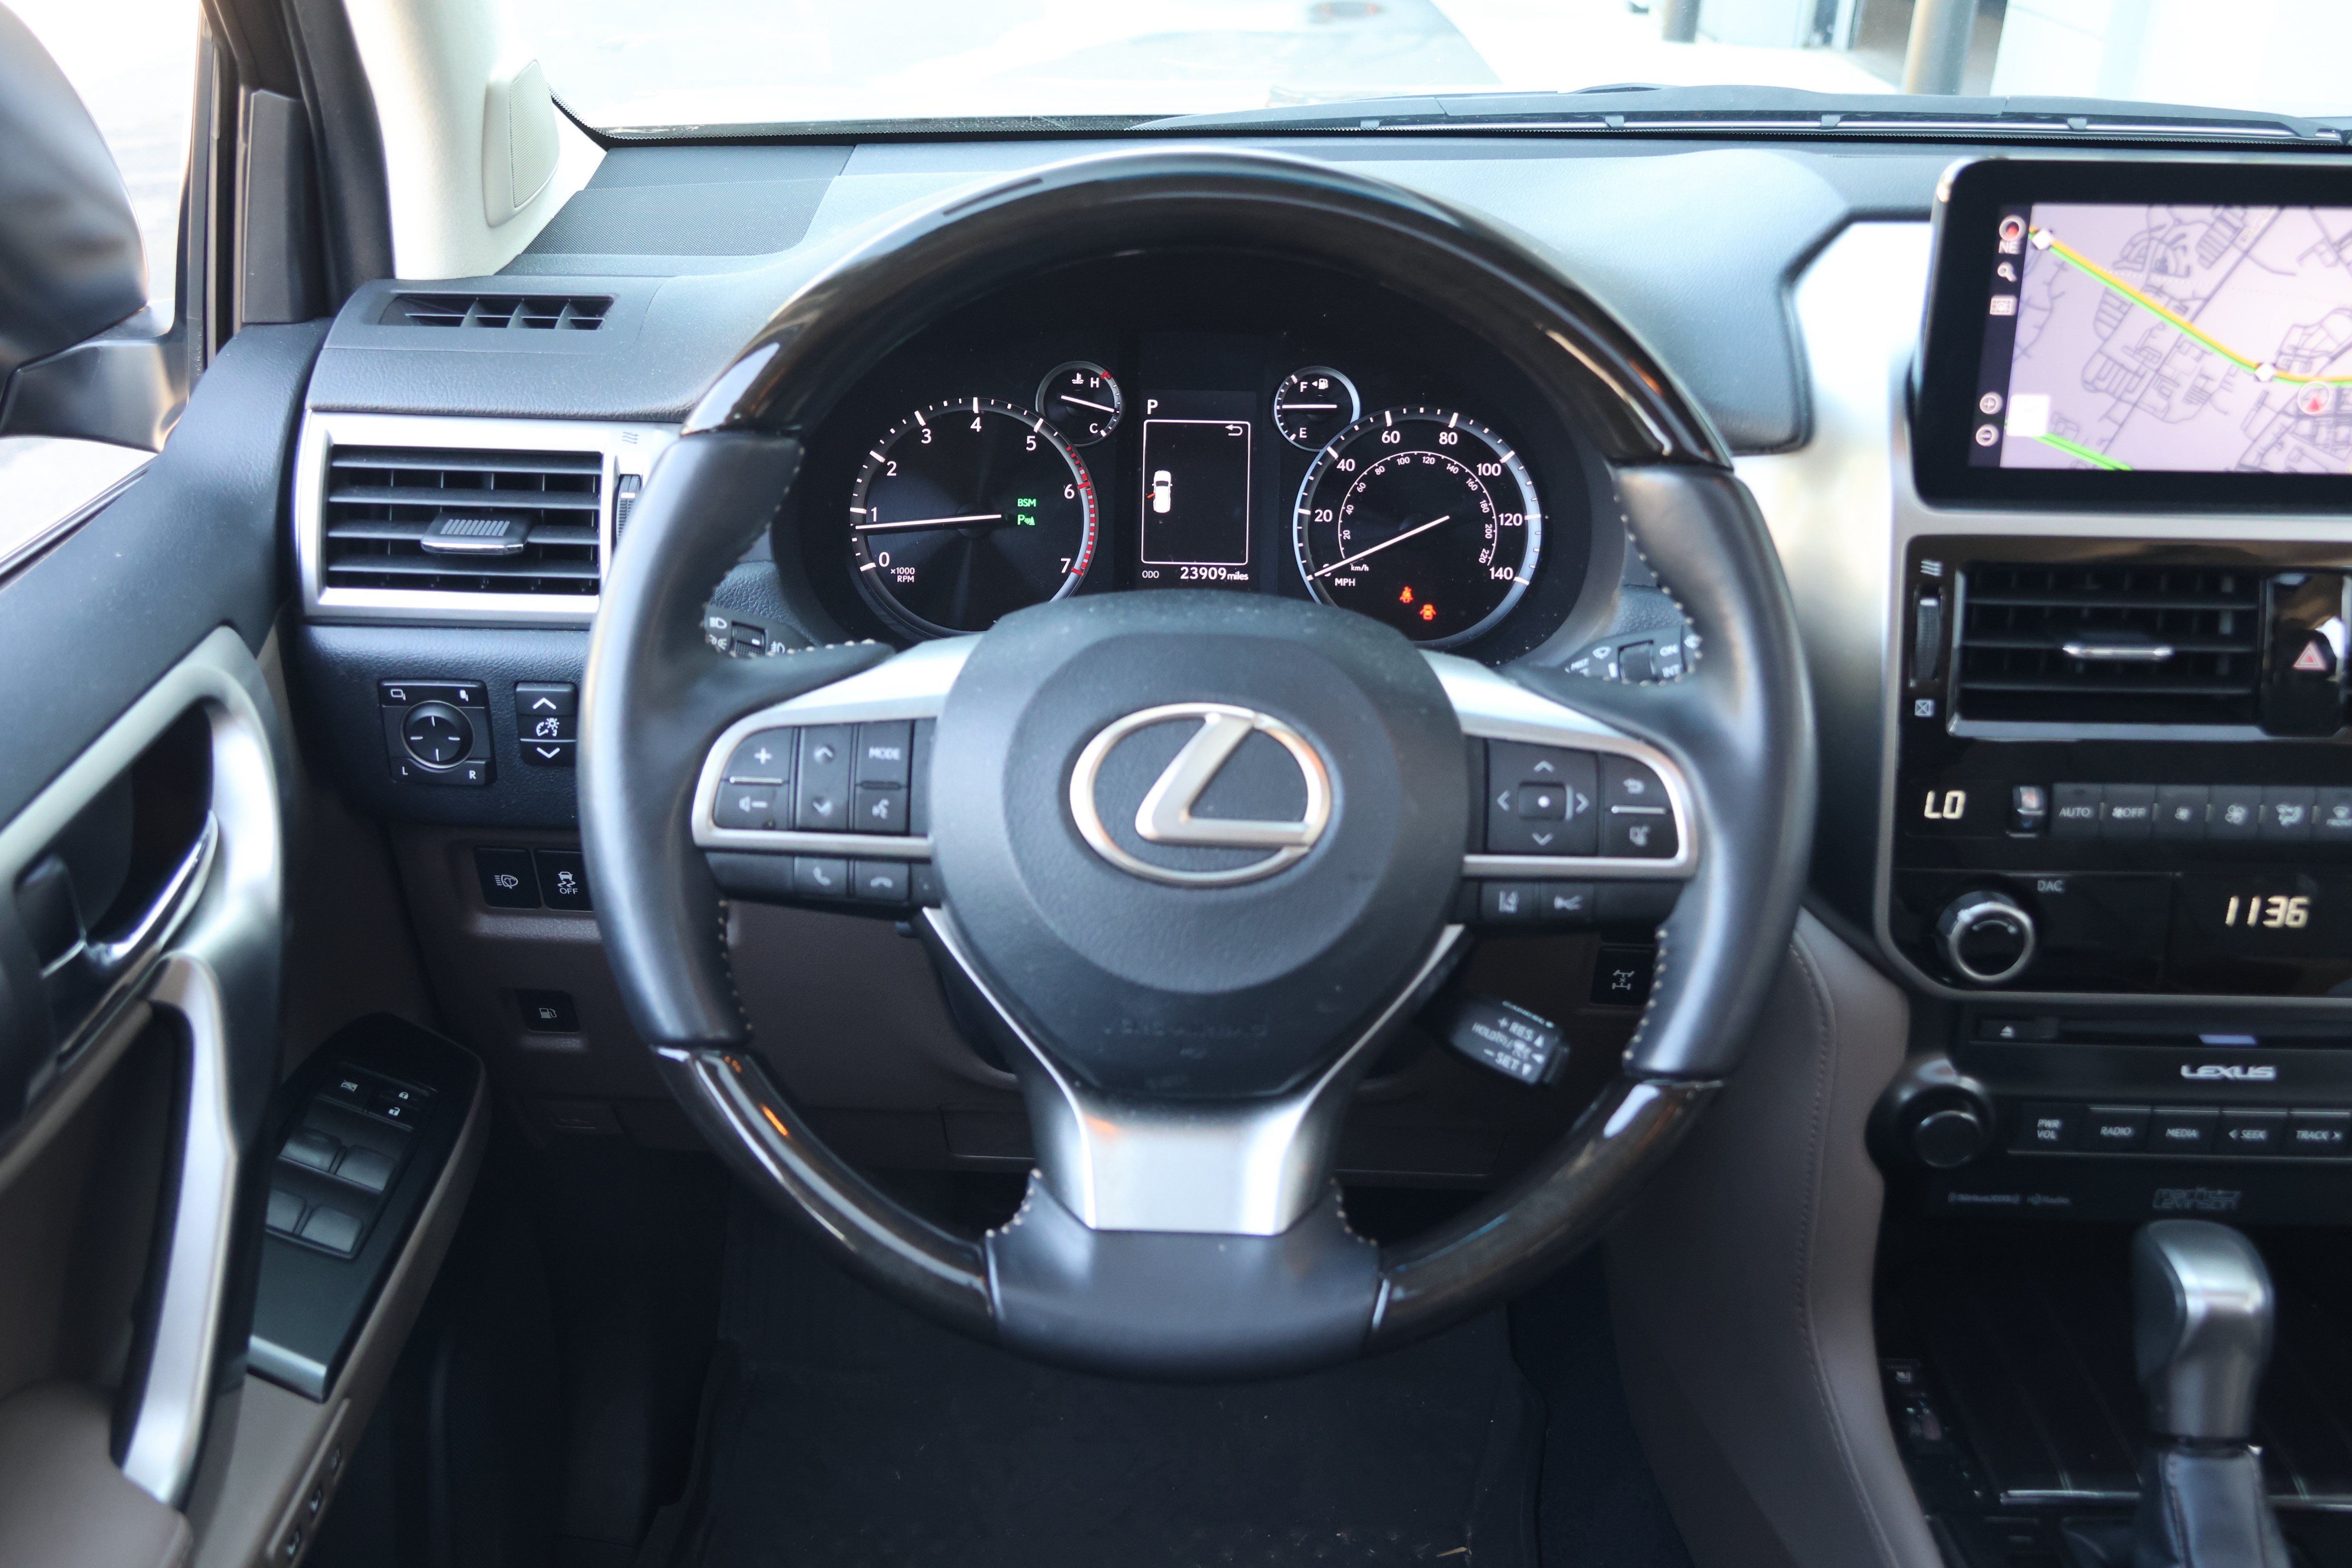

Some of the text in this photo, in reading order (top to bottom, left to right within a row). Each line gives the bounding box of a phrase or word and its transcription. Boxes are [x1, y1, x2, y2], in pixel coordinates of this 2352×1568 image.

[1999, 240, 2020, 254] NE
[1091, 377, 1099, 388] H
[1301, 382, 1307, 392] F
[1147, 399, 1158, 414] P
[971, 417, 981, 432] 4
[1089, 423, 1098, 433] C
[921, 429, 931, 443] 3
[1300, 428, 1307, 438] E
[1382, 431, 1400, 443] 60
[1439, 432, 1457, 445] 80
[1026, 436, 1036, 450] 5
[1337, 459, 1355, 471] 40
[1396, 456, 1410, 465] 100
[887, 461, 896, 476] 2
[1375, 465, 1385, 475] 80
[1446, 463, 1459, 474] 140
[1477, 463, 1501, 476] 100
[1356, 482, 1366, 492] 60
[1466, 478, 1478, 491] 160
[1065, 484, 1074, 499] 6
[1018, 499, 1036, 507] BSM
[1480, 499, 1489, 513] 180
[871, 507, 876, 521] 1
[1314, 509, 1332, 522] 20
[1346, 505, 1354, 514] 40
[1499, 513, 1522, 526] 120
[1343, 530, 1350, 539] 20
[879, 552, 889, 567] 0
[1479, 548, 1489, 563] 220
[1061, 558, 1071, 573] 7
[1180, 567, 1226, 579] 23909
[1227, 572, 1248, 580] miles
[1490, 567, 1513, 580] 140
[1660, 644, 1679, 657] ON
[869, 747, 900, 760] MODE
[402, 767, 408, 775] L
[469, 771, 476, 779] R
[1924, 791, 1965, 819] LO
[2059, 806, 2093, 817] AUTO
[2123, 808, 2145, 817] OFF
[2038, 880, 2062, 891] DAC
[1495, 1051, 1520, 1071] SET
[2181, 1066, 2276, 1080] LEXUS
[2038, 1119, 2061, 1129] PWR
[2038, 1130, 2056, 1140] VOL
[2100, 1127, 2133, 1136] RADIO
[2166, 1129, 2198, 1138] MEDIA
[2241, 1130, 2267, 1140] SEEK
[2297, 1131, 2329, 1140] TRACK
